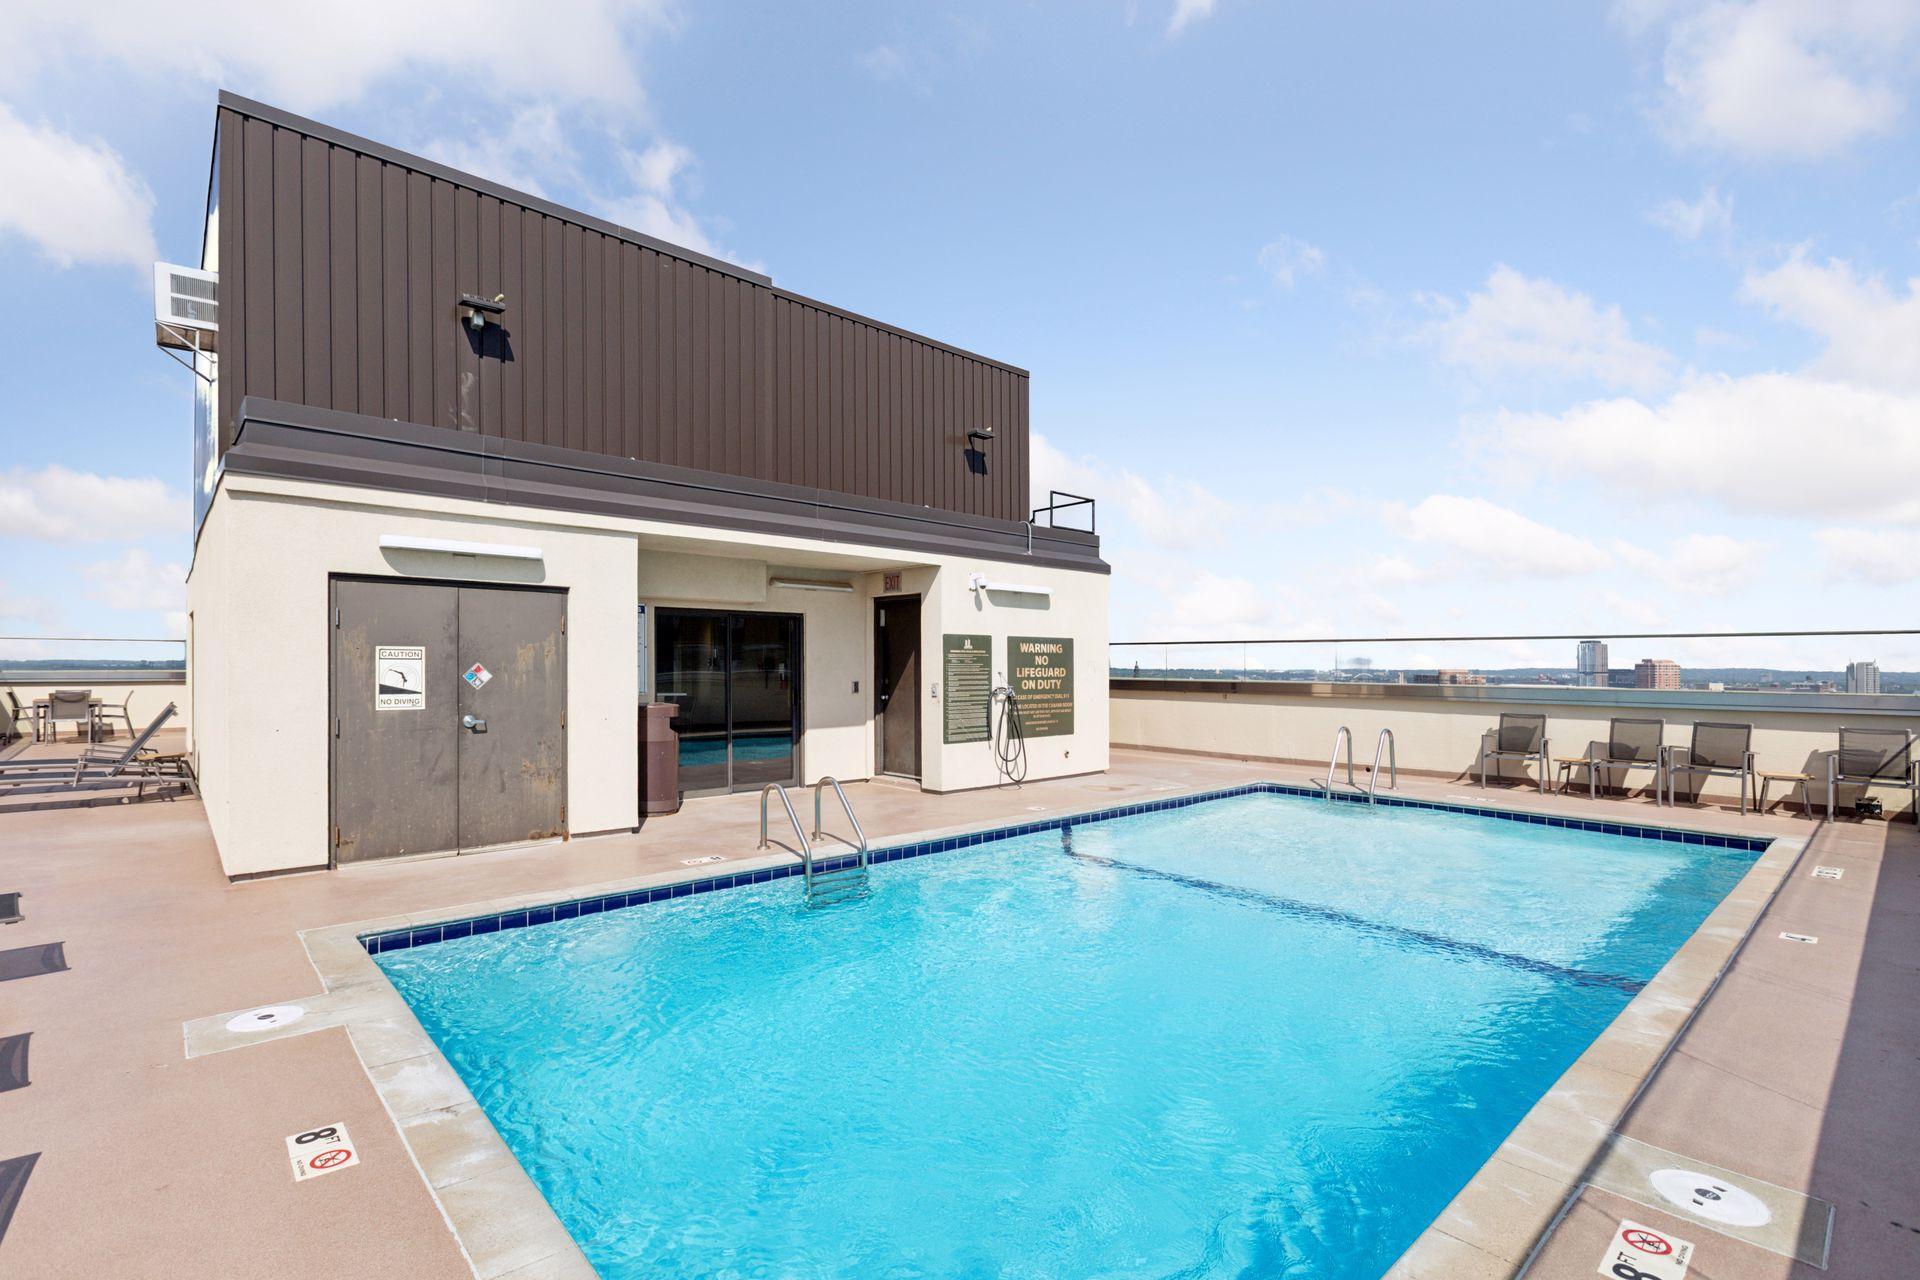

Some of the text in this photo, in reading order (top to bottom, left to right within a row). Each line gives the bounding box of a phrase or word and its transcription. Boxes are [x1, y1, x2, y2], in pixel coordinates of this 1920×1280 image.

[884, 576, 900, 590] EXIT
[1020, 643, 1063, 653] WARNING
[1035, 656, 1049, 665] NO
[1016, 668, 1066, 677] LIFEGUARD
[1022, 679, 1062, 689] ON DUTY
[295, 1127, 337, 1145] 8
[1617, 1251, 1637, 1266] FT
